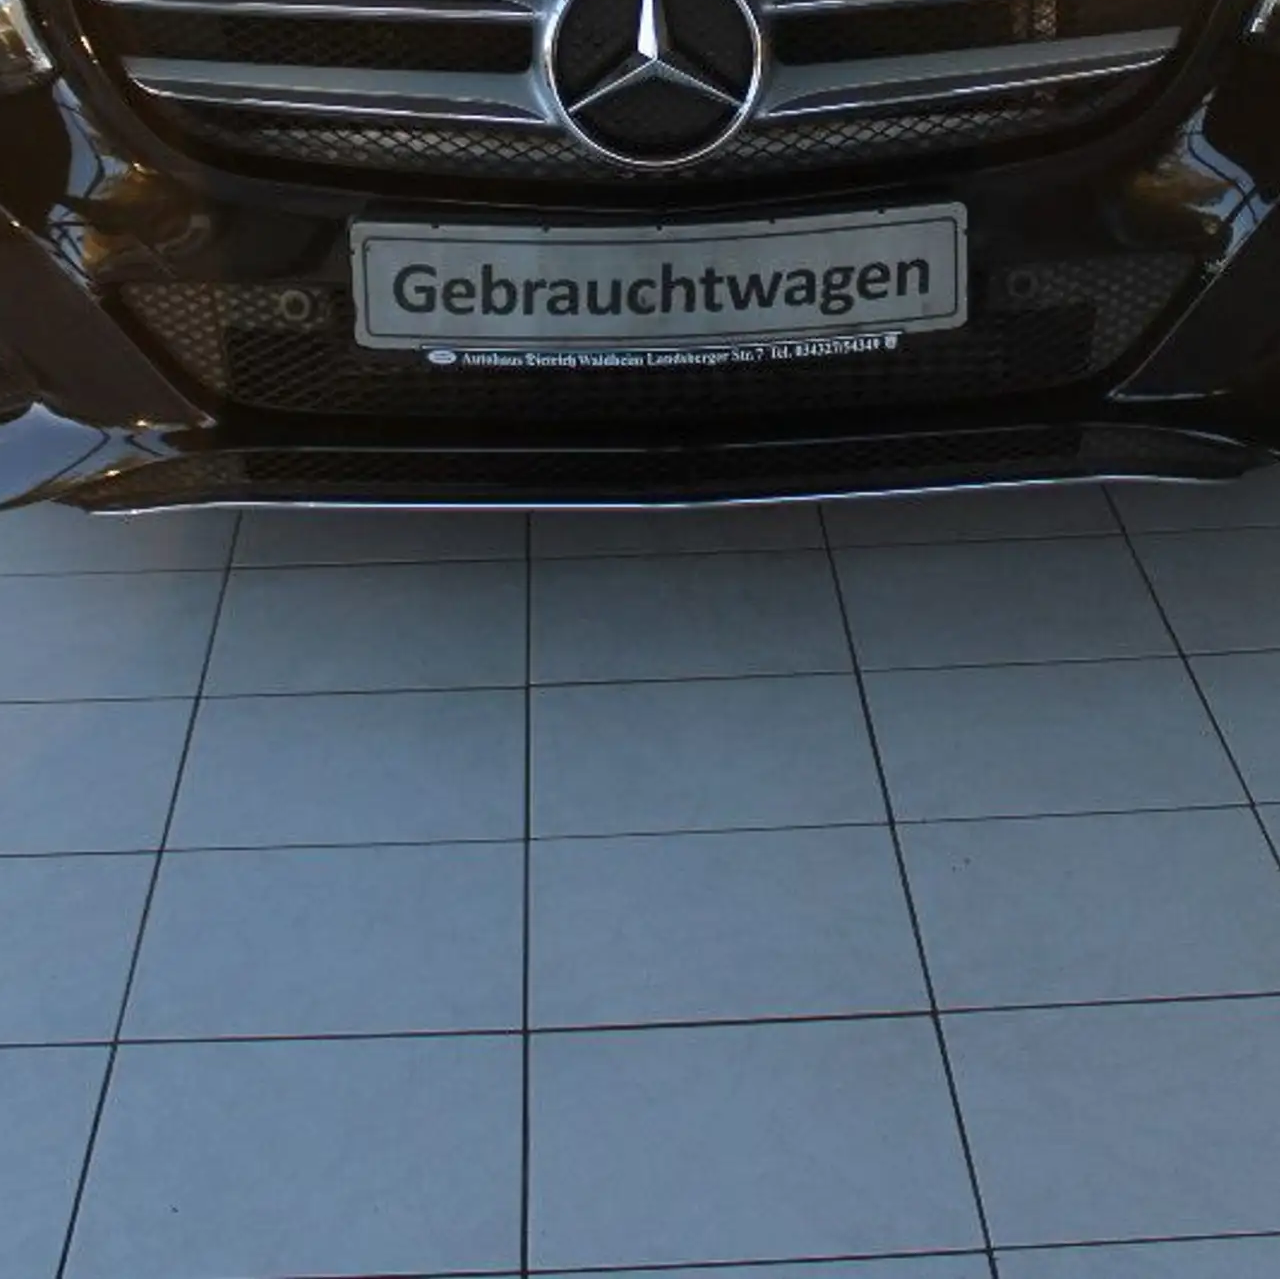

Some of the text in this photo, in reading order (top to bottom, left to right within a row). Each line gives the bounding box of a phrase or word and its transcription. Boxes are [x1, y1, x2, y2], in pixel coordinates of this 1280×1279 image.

[392, 256, 929, 317] Gebrauchtwagen
[462, 352, 523, 366] Autohaus
[578, 352, 644, 366] Waldheim
[771, 345, 792, 360] Tel.
